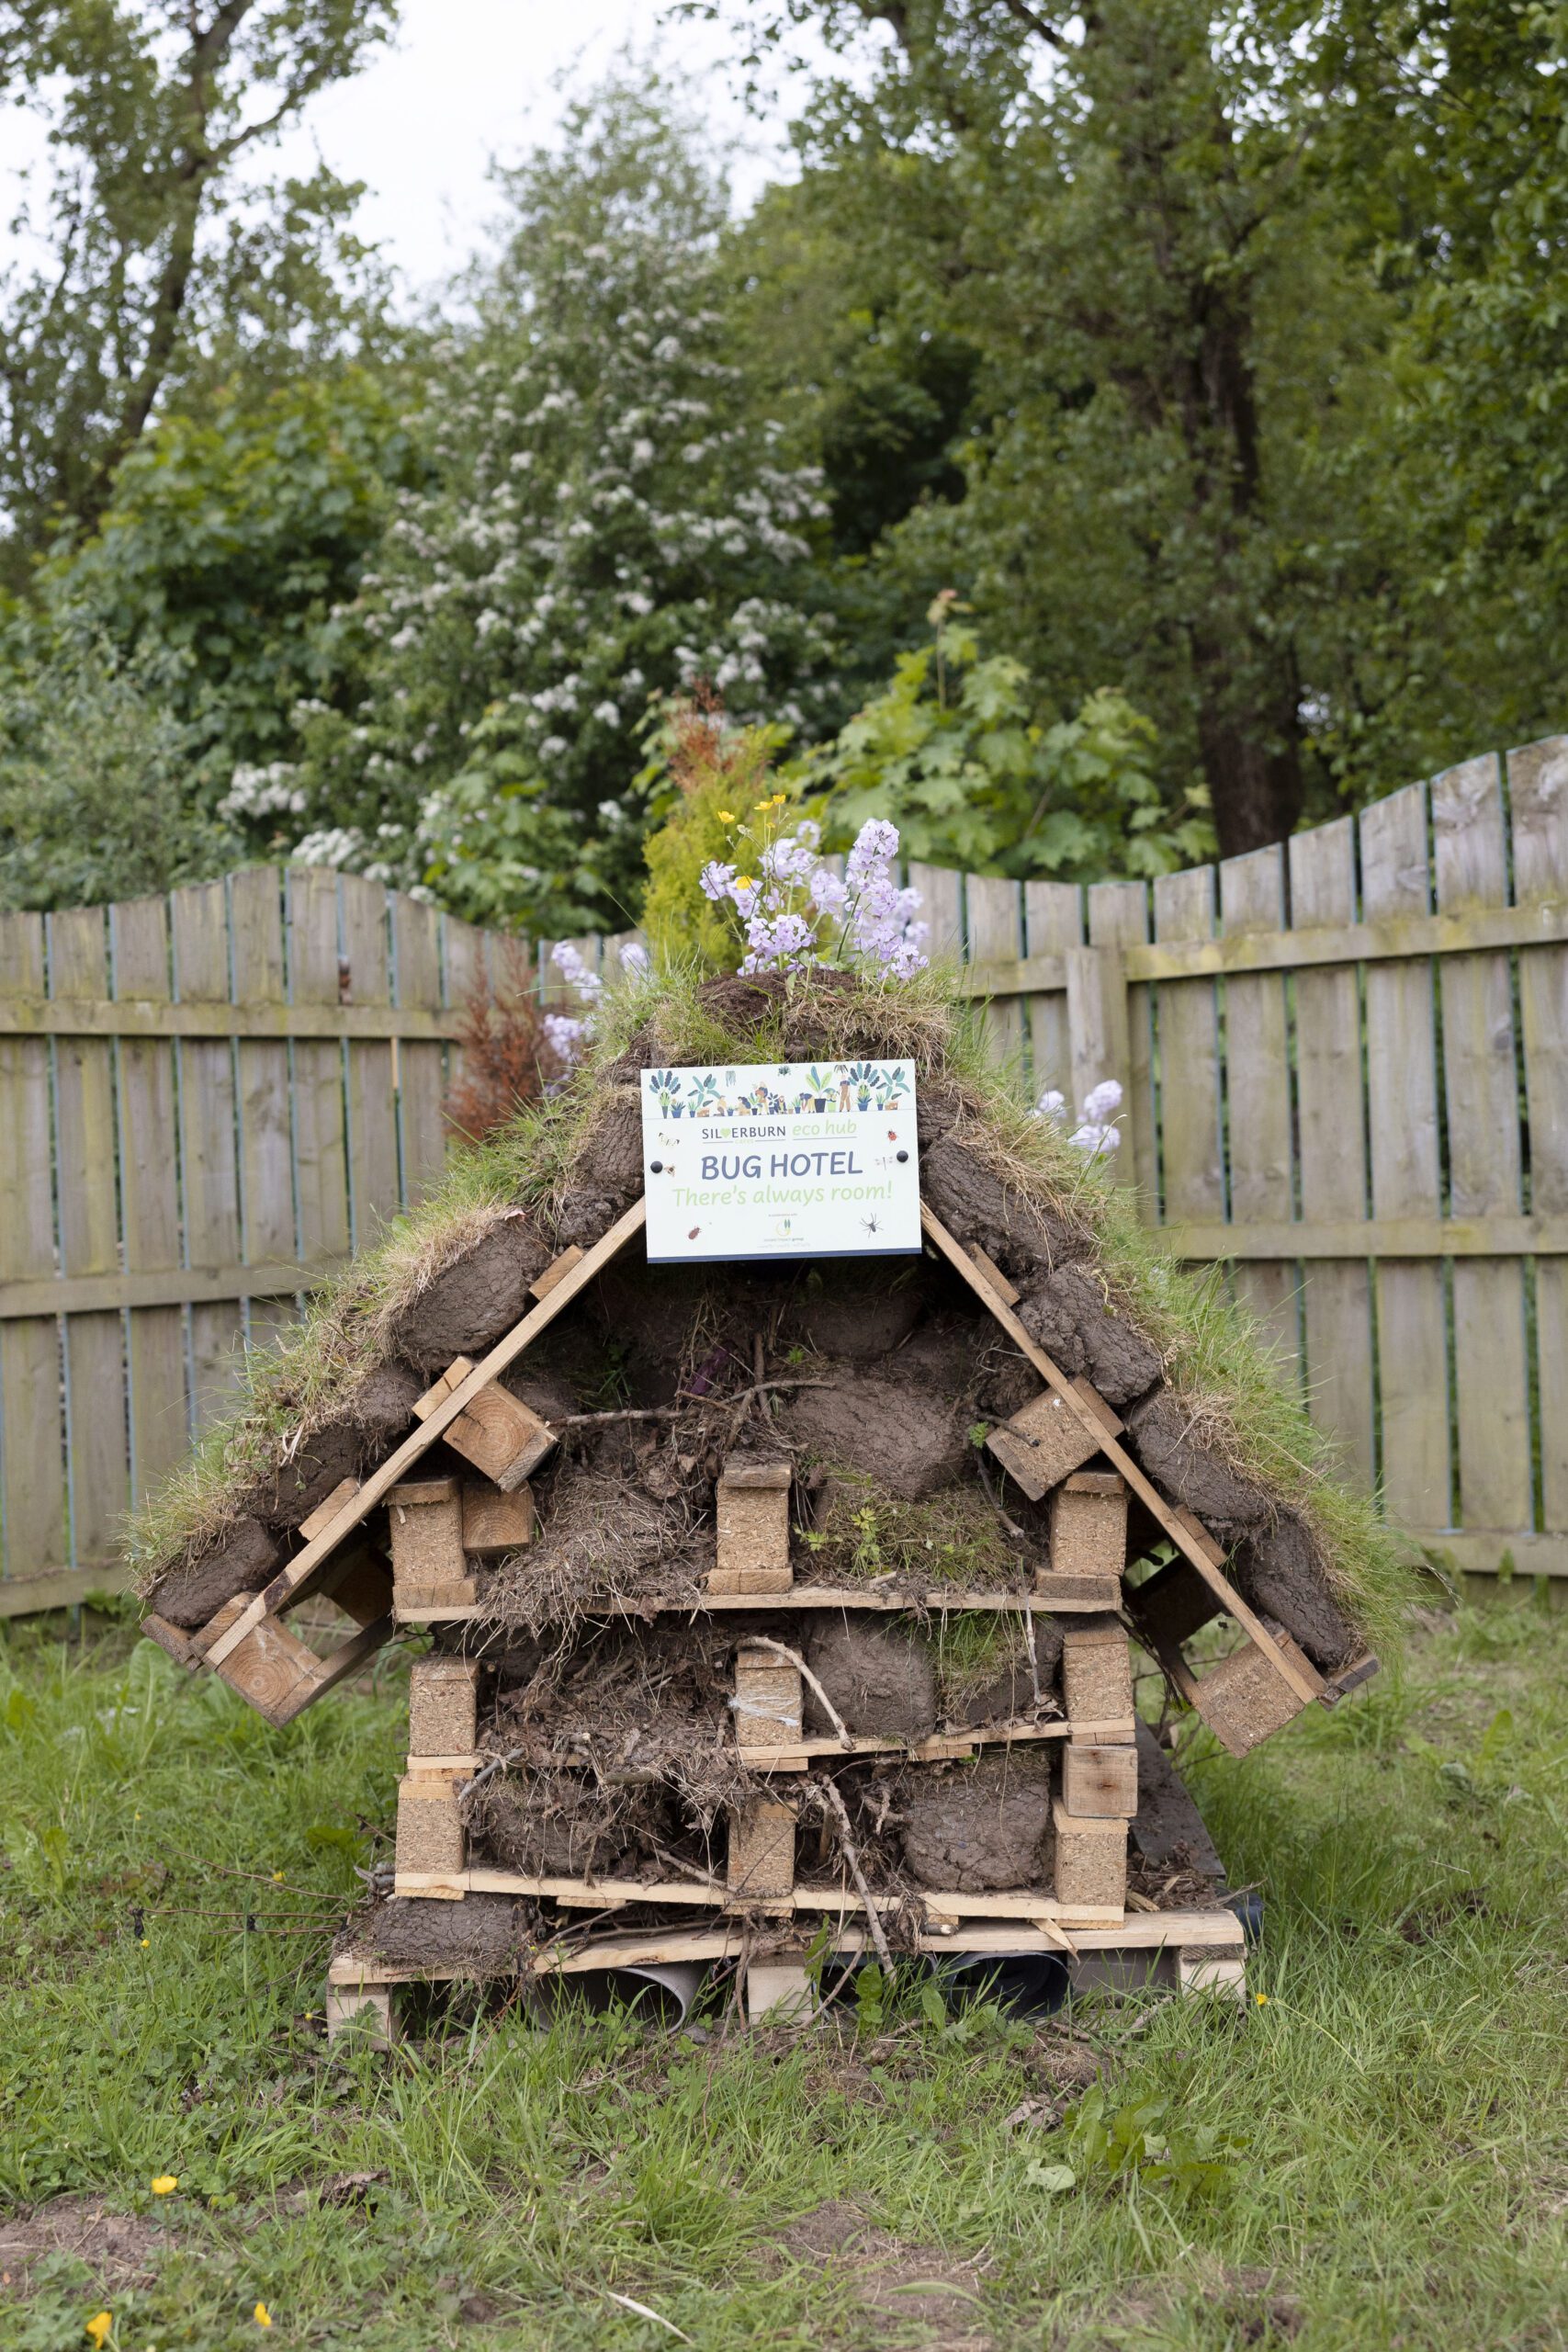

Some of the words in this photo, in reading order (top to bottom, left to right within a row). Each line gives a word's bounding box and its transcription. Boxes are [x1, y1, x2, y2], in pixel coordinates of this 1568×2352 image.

[793, 1124, 820, 1136] eco
[826, 1118, 857, 1136] hub
[701, 1155, 761, 1181] BUG
[770, 1151, 863, 1178] HOTEL
[671, 1184, 747, 1207] There's
[752, 1183, 825, 1207] always
[830, 1180, 893, 1202] room!
